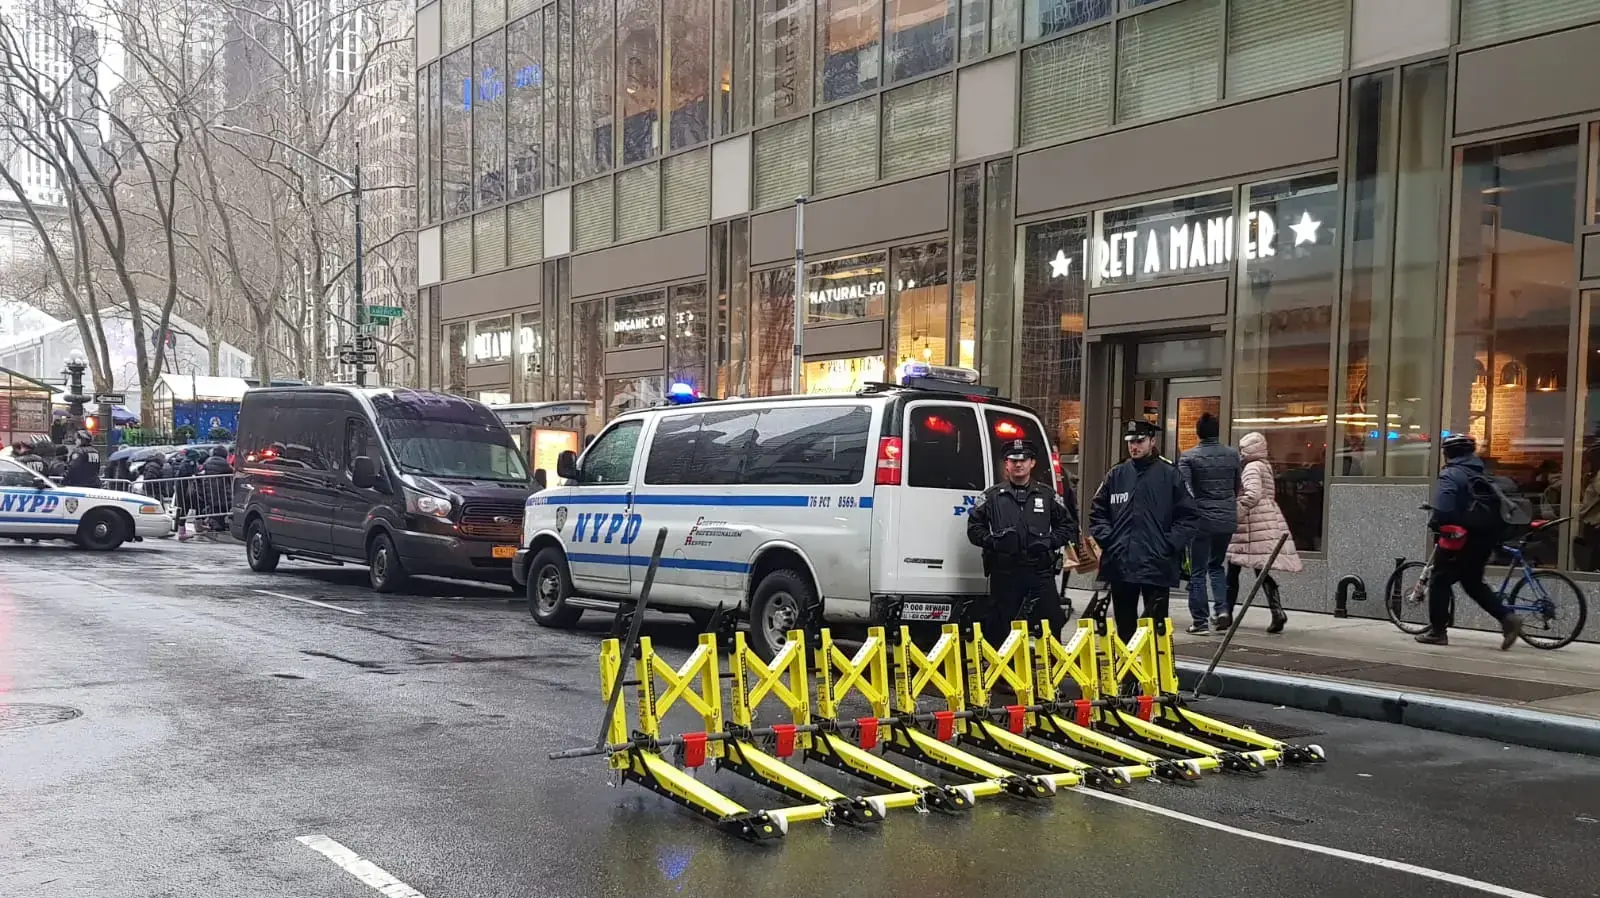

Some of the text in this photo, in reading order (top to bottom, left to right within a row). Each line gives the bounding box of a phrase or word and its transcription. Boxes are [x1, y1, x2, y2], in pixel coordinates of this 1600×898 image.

[1143, 229, 1161, 274] A
[810, 284, 865, 304] NATURAL
[614, 311, 686, 333] ORGANIC COEE
[0, 495, 59, 513] NYPD
[809, 496, 831, 508] 76 PCT
[1110, 492, 1129, 504] NYPD
[572, 513, 643, 545] NYPD
[925, 604, 950, 612] REWARD
